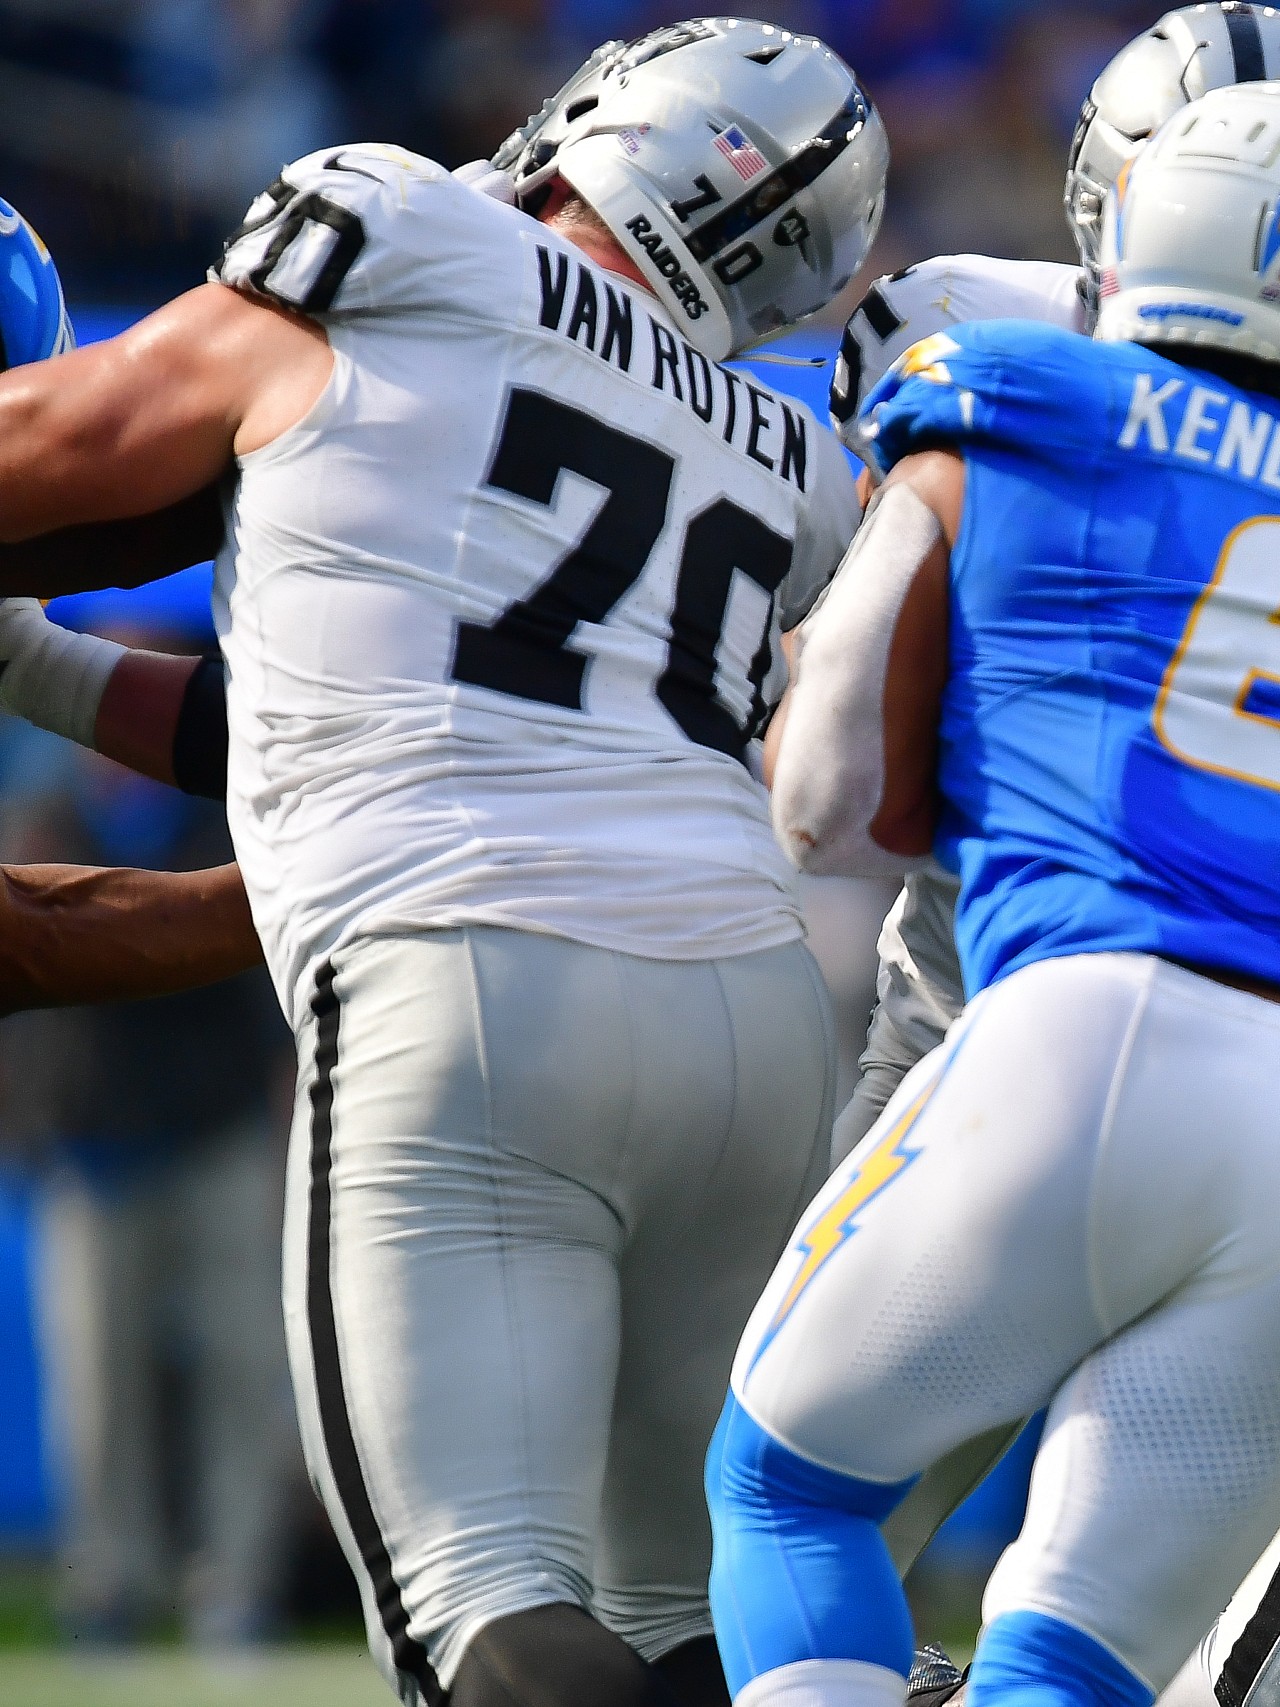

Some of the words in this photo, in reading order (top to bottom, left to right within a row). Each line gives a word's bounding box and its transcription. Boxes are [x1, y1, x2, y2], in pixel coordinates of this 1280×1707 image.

[536, 244, 632, 372] VAN
[648, 314, 806, 493] ROTEN
[625, 213, 709, 319] RAIDERS
[449, 384, 795, 766] 70
